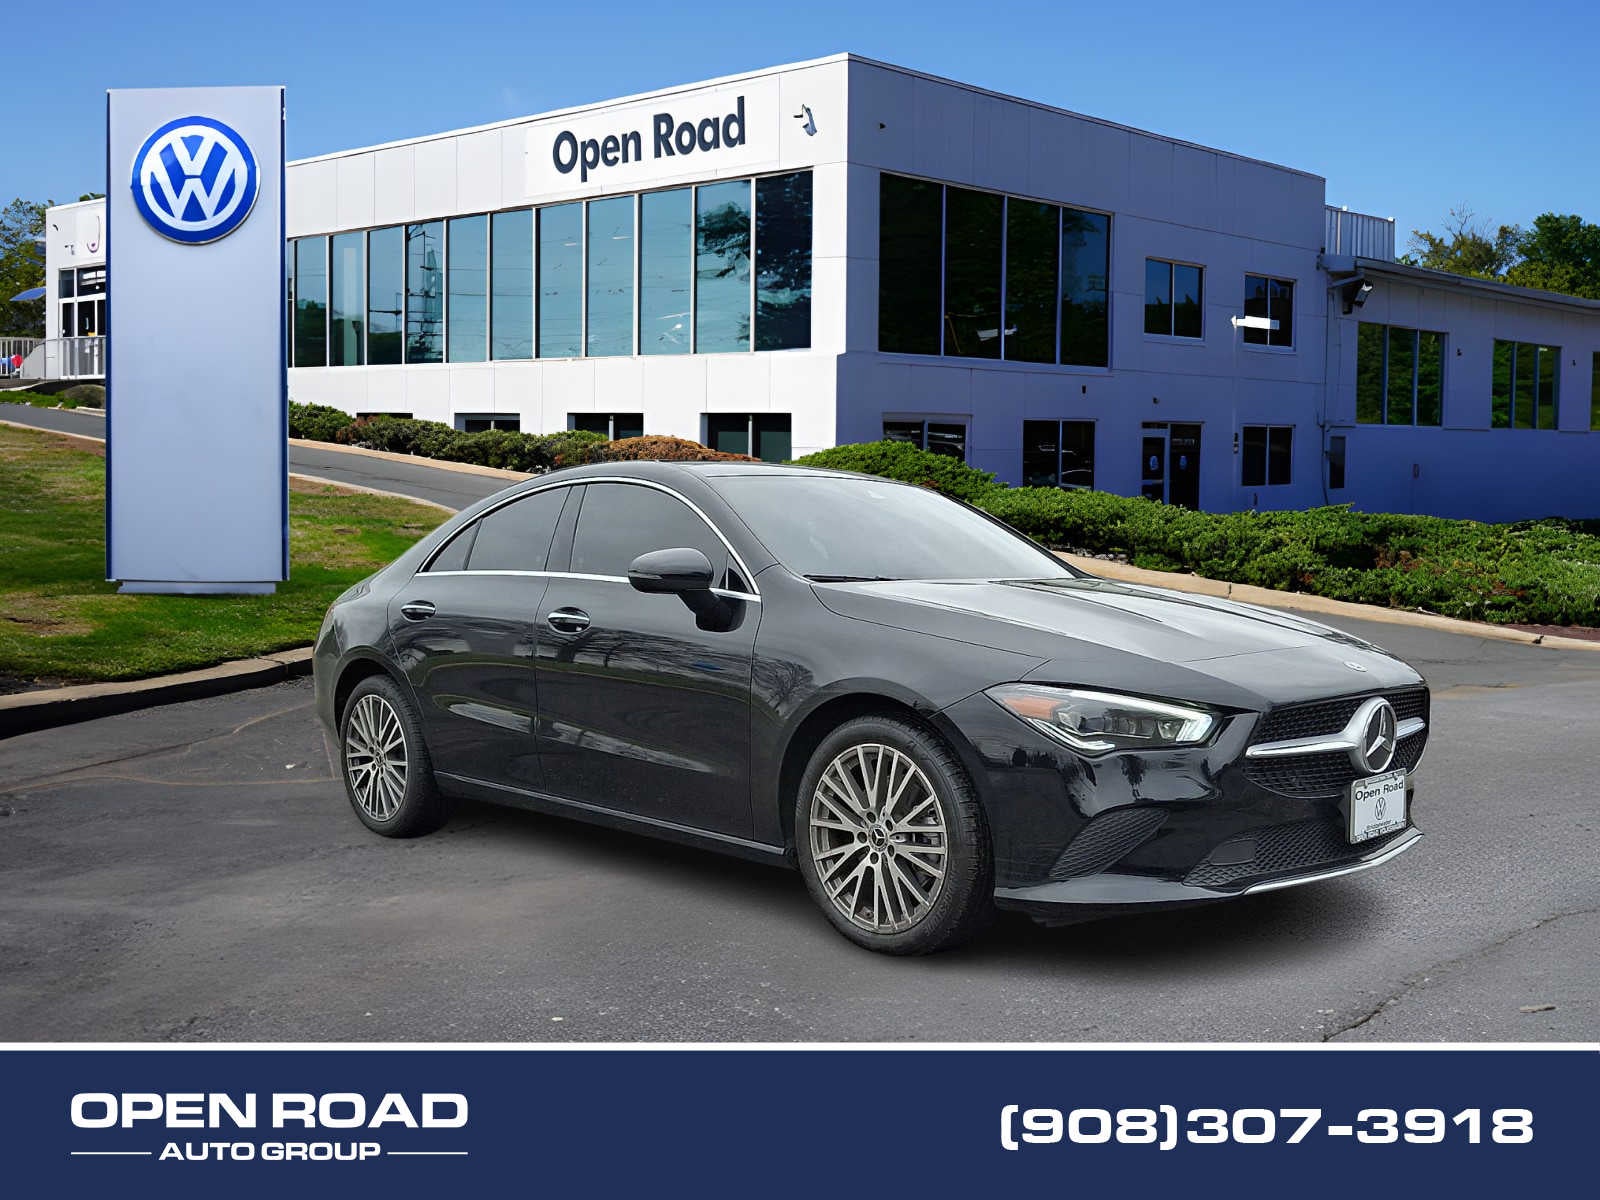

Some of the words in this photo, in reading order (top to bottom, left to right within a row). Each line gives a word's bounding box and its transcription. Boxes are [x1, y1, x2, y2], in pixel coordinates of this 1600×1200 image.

[552, 130, 642, 183] Open
[653, 96, 746, 158] Road
[1355, 788, 1380, 801] Open
[1383, 781, 1404, 794] Road
